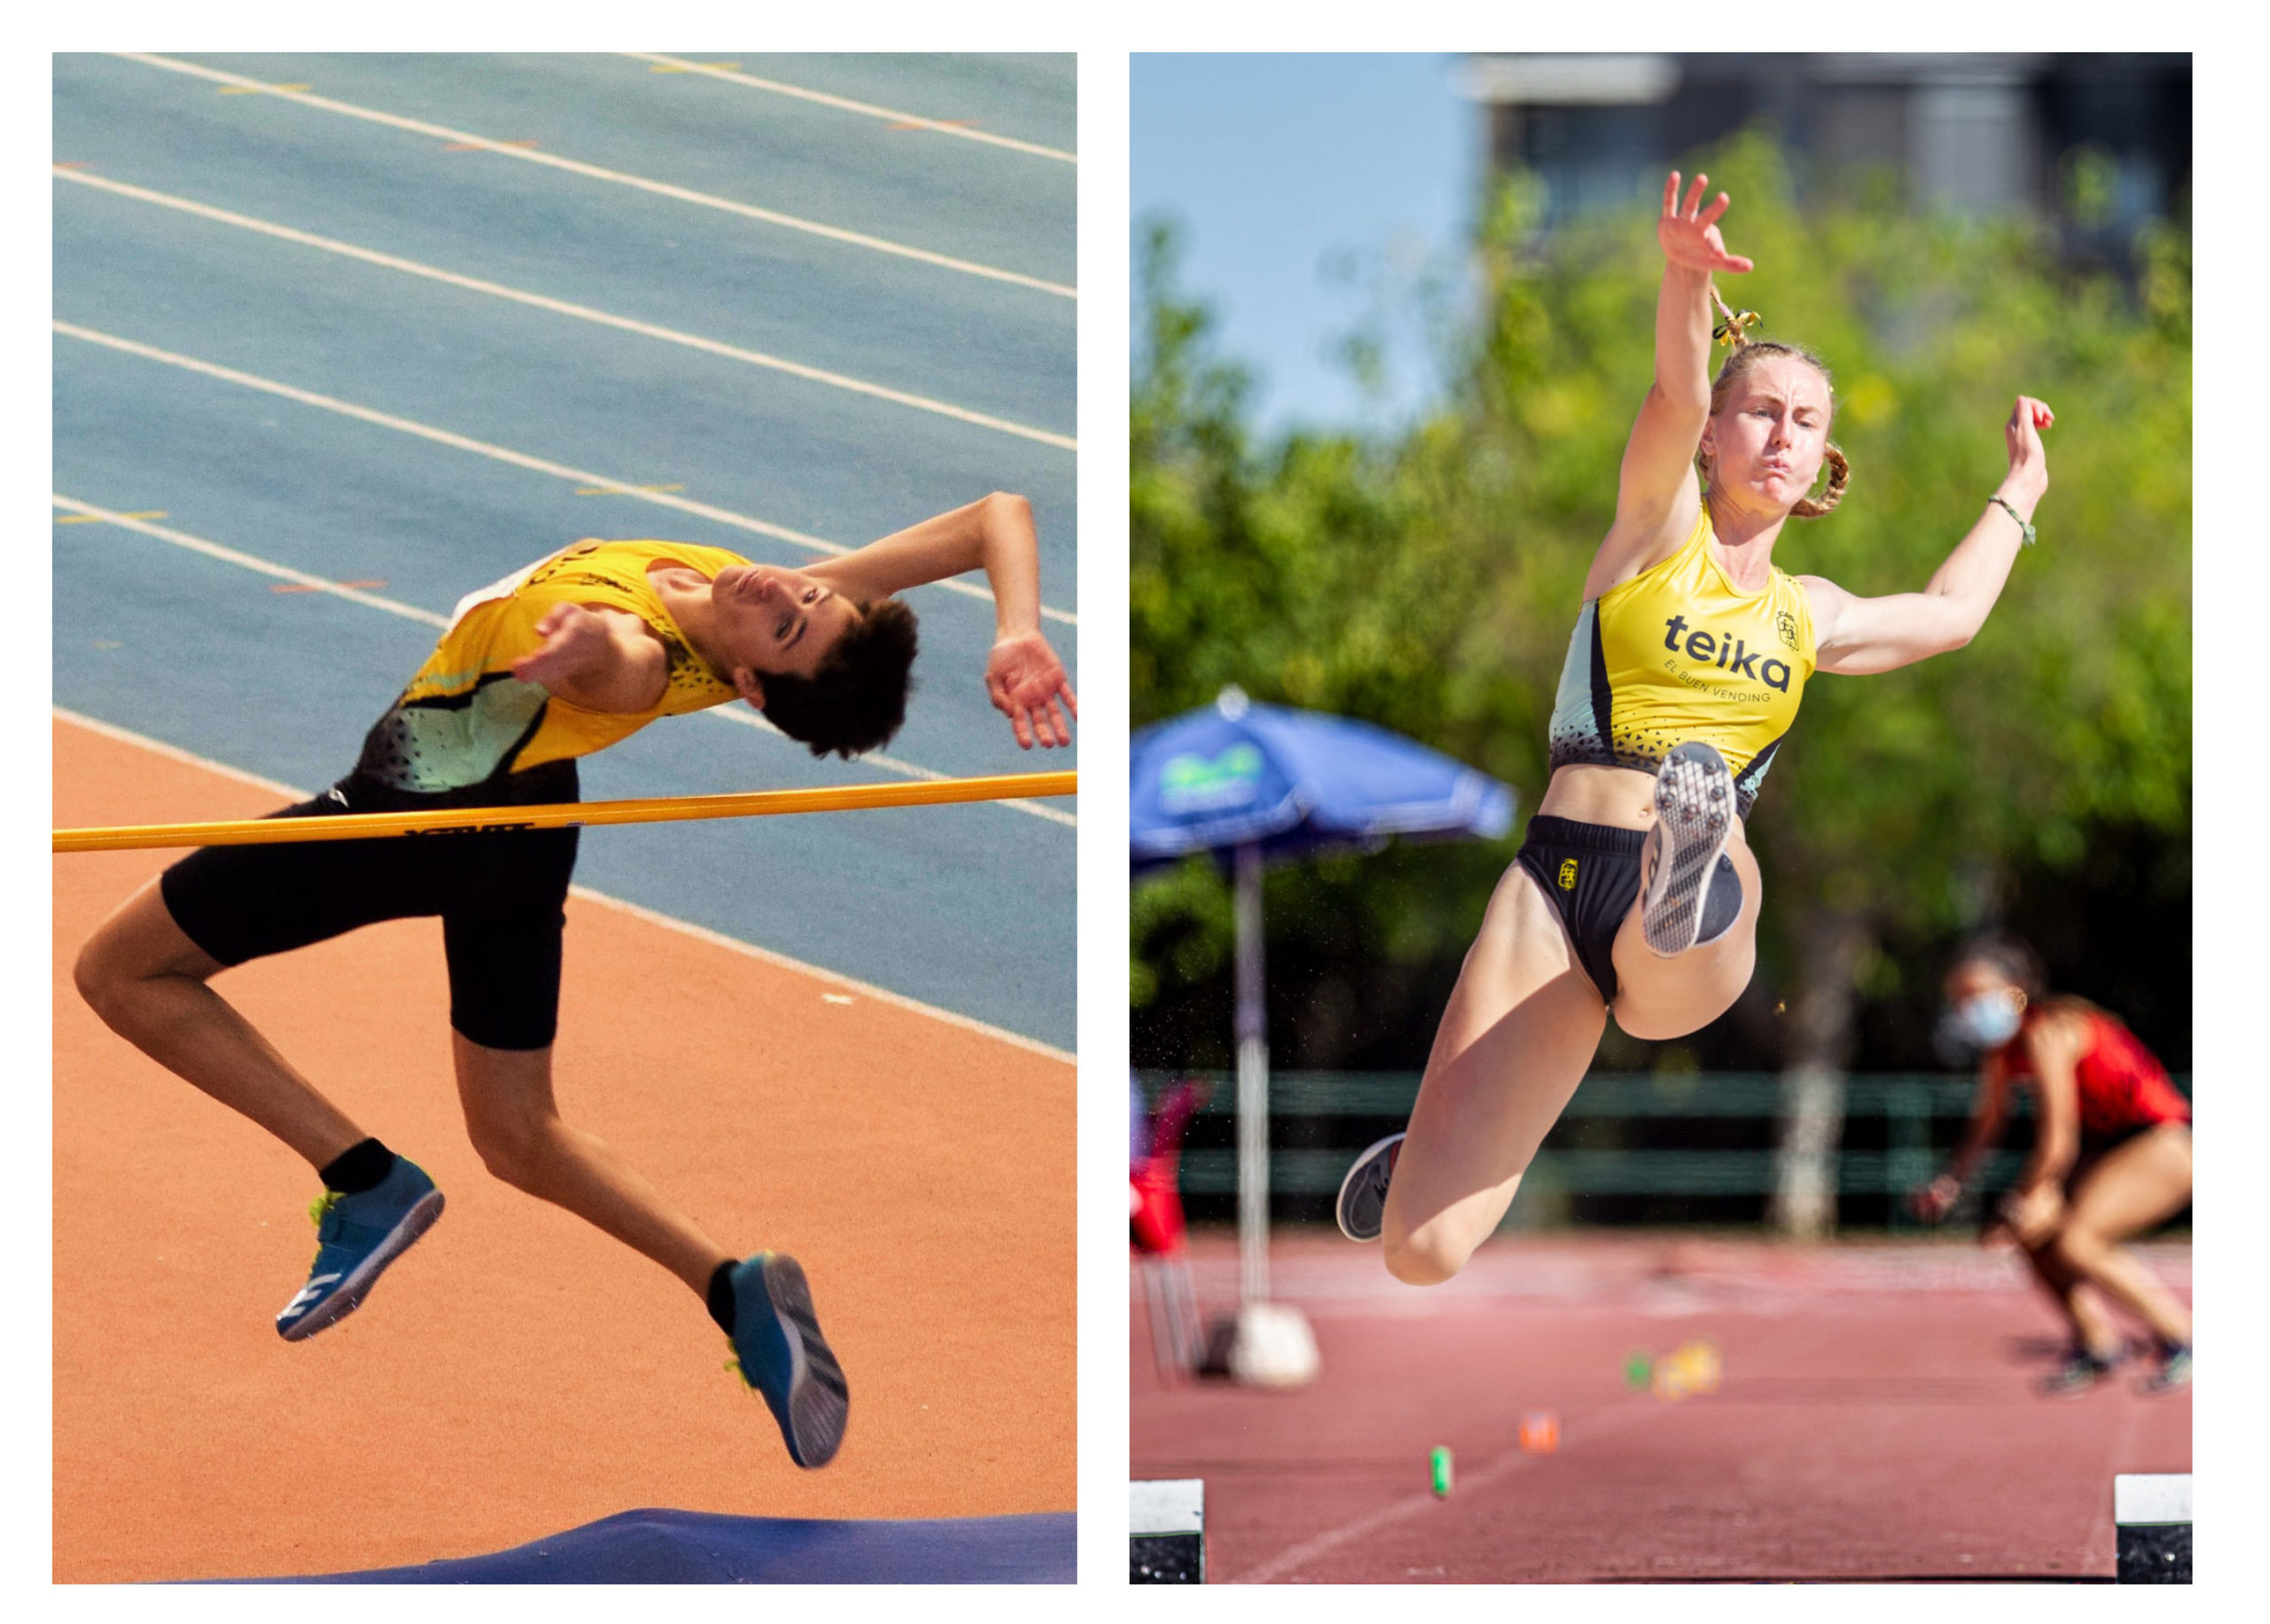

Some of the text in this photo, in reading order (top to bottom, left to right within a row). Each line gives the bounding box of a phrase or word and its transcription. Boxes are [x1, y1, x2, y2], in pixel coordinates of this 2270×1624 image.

[1663, 614, 1791, 694] teika
[1663, 660, 1772, 703] EL BUEN VENDING
